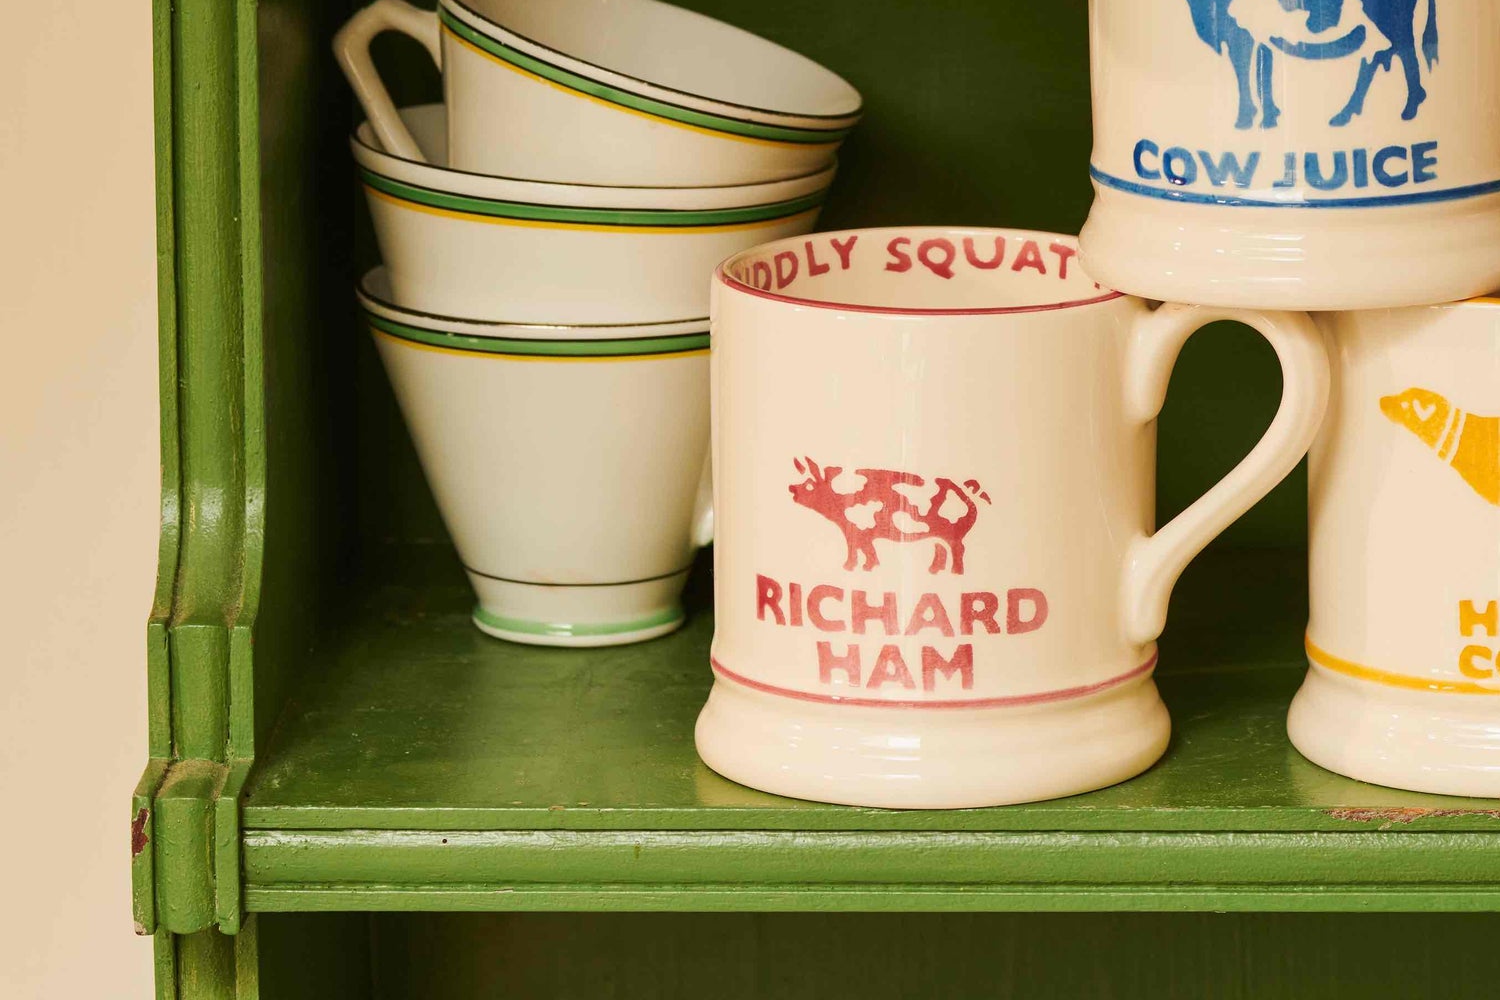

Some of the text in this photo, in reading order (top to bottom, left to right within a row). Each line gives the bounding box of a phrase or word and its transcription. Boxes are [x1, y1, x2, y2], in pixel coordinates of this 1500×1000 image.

[1133, 138, 1438, 190] COW JUICE
[885, 236, 1076, 280] SQUAT
[756, 573, 1049, 637] RICHARD
[816, 640, 975, 692] HAM
